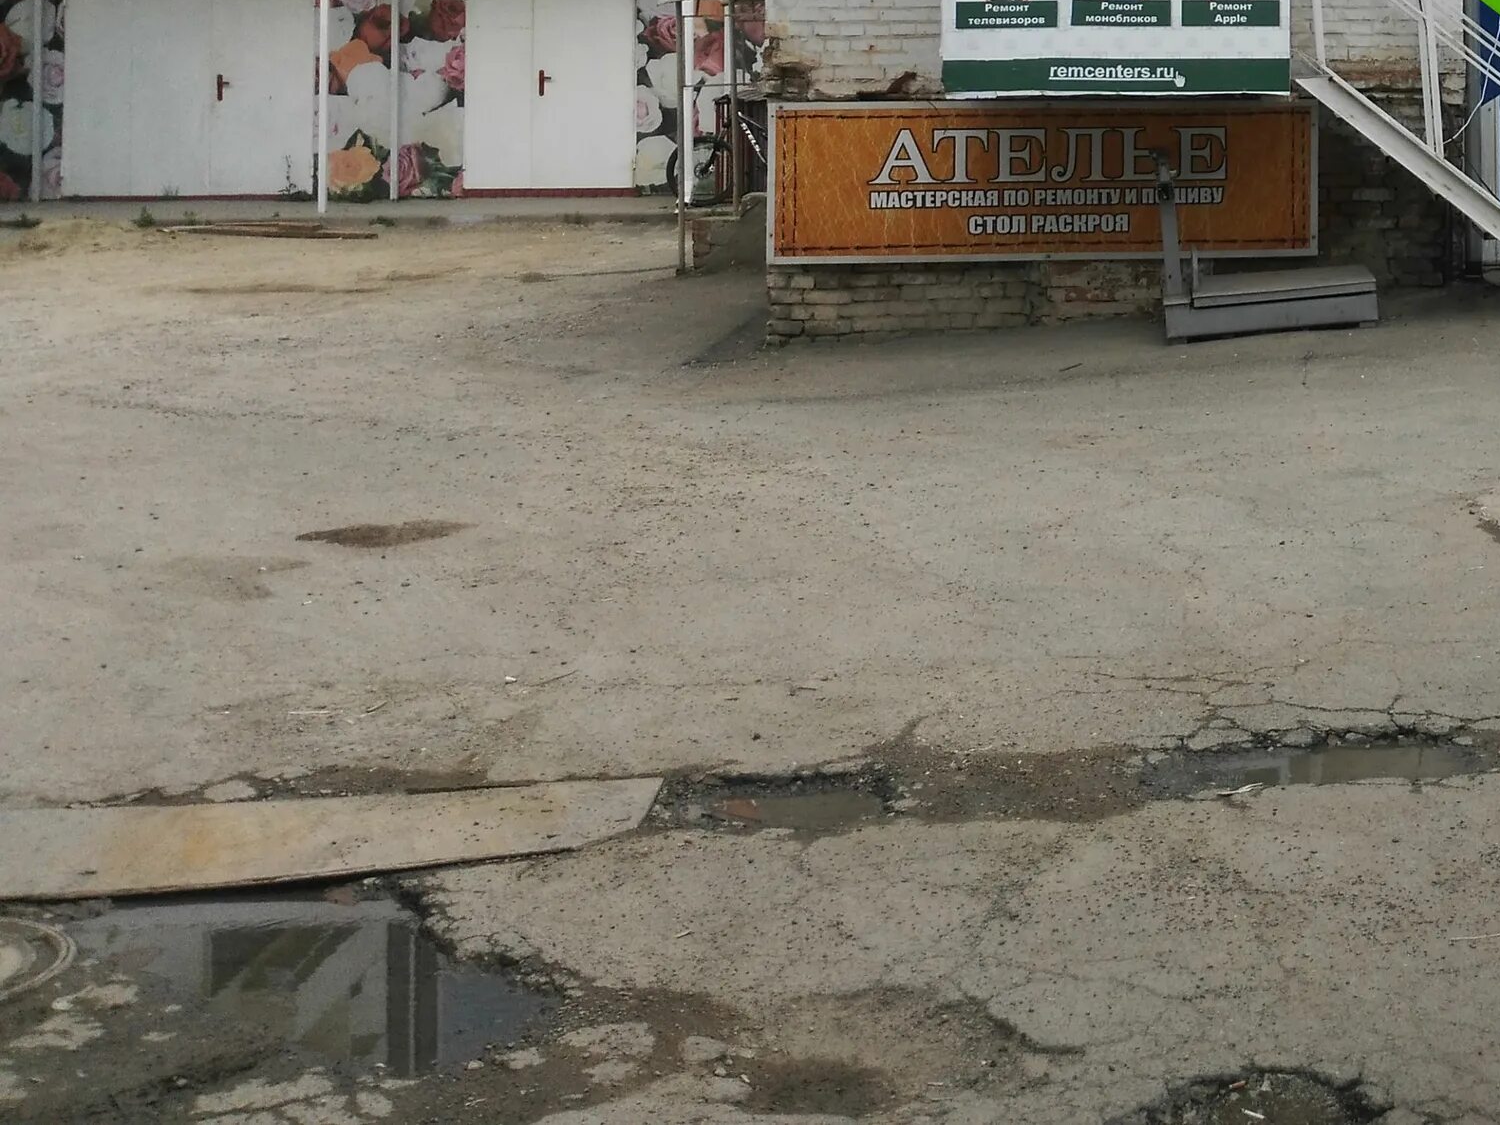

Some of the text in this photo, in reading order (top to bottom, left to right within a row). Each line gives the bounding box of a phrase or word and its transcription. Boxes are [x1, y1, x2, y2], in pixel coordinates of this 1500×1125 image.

[985, 2, 1029, 13] Ремонт
[1101, 0, 1144, 12] Ремонт
[1210, 1, 1253, 12] Ремонт
[968, 14, 1046, 26] телевизоров
[1085, 13, 1158, 24] моноблоков
[1214, 12, 1248, 24] Apple
[1049, 63, 1175, 79] remcenters.ru
[867, 125, 1228, 186] АТЕЛЬЕ
[869, 185, 1225, 210] МАСТЕРСКАЯ ПО РЕМОНТУ И ПШИВУ
[967, 213, 1131, 236] СТОЛ РАСКРОЯ
